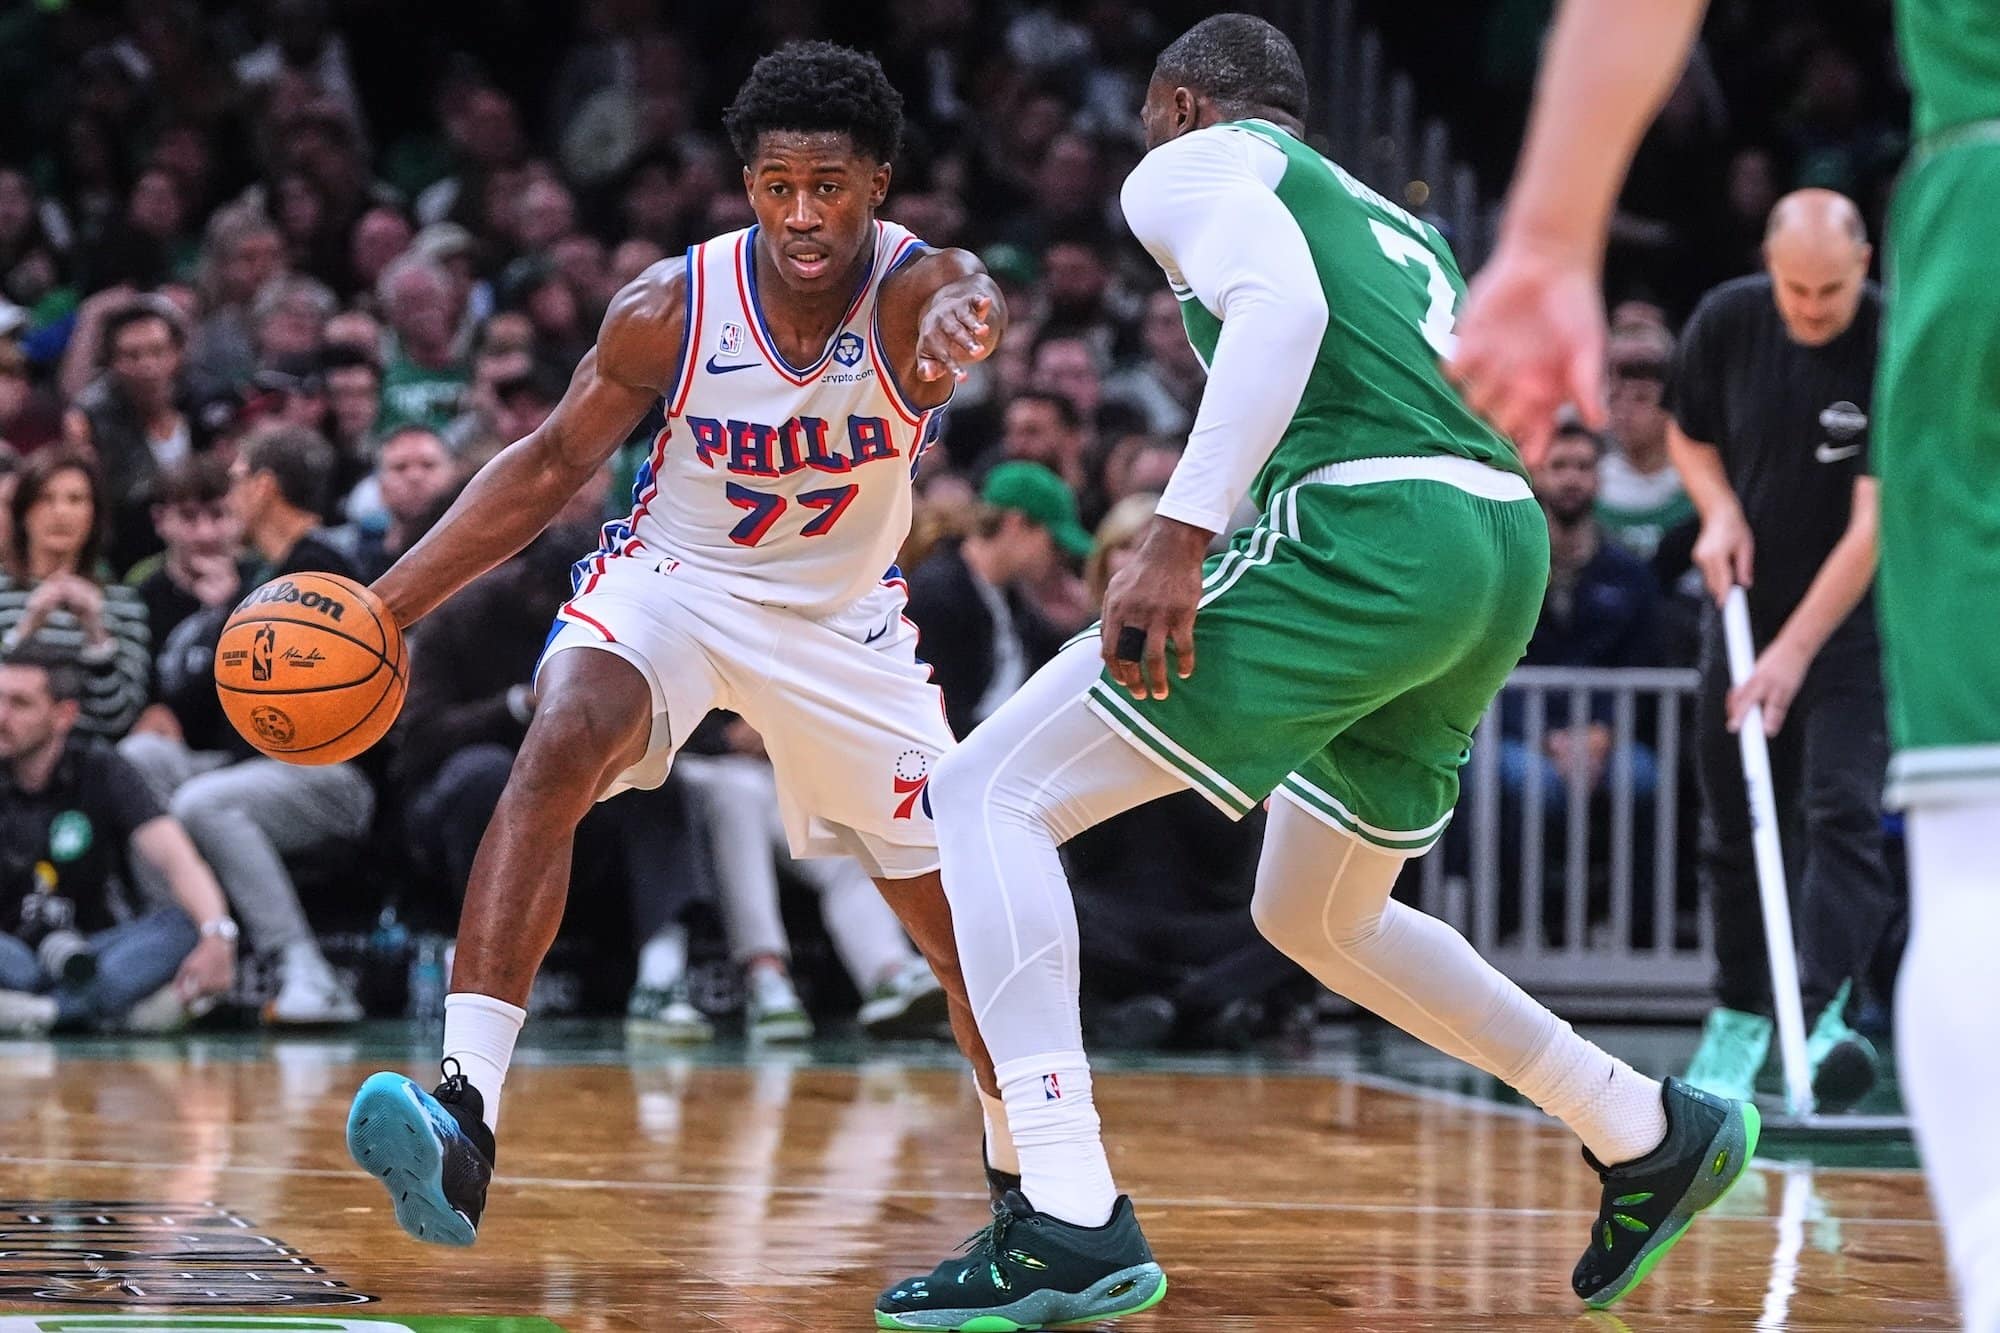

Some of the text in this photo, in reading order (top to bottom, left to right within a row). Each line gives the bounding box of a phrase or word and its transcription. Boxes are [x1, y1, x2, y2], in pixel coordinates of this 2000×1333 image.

[1367, 217, 1462, 362] 7
[821, 369, 874, 383] crypto.com
[686, 414, 900, 477] PHILA
[726, 481, 859, 547] 77
